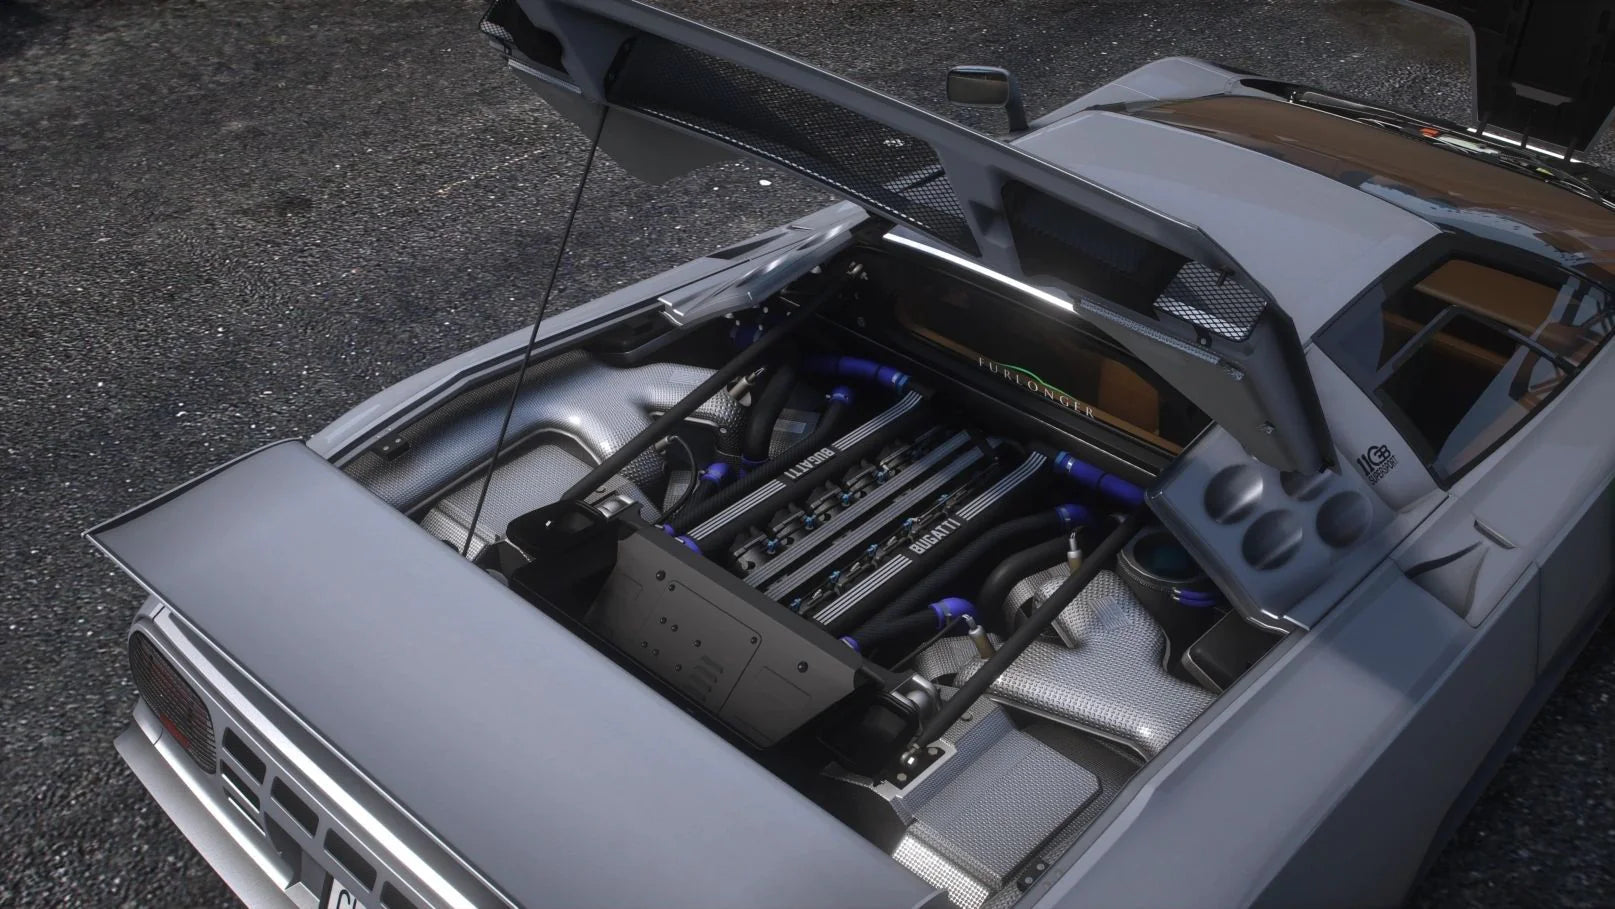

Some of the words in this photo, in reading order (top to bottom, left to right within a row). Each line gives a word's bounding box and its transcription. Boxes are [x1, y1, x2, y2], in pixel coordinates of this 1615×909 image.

[978, 357, 1095, 418] FURLONGER
[783, 447, 836, 479] BUGATTI
[908, 517, 961, 554] BUGATTI
